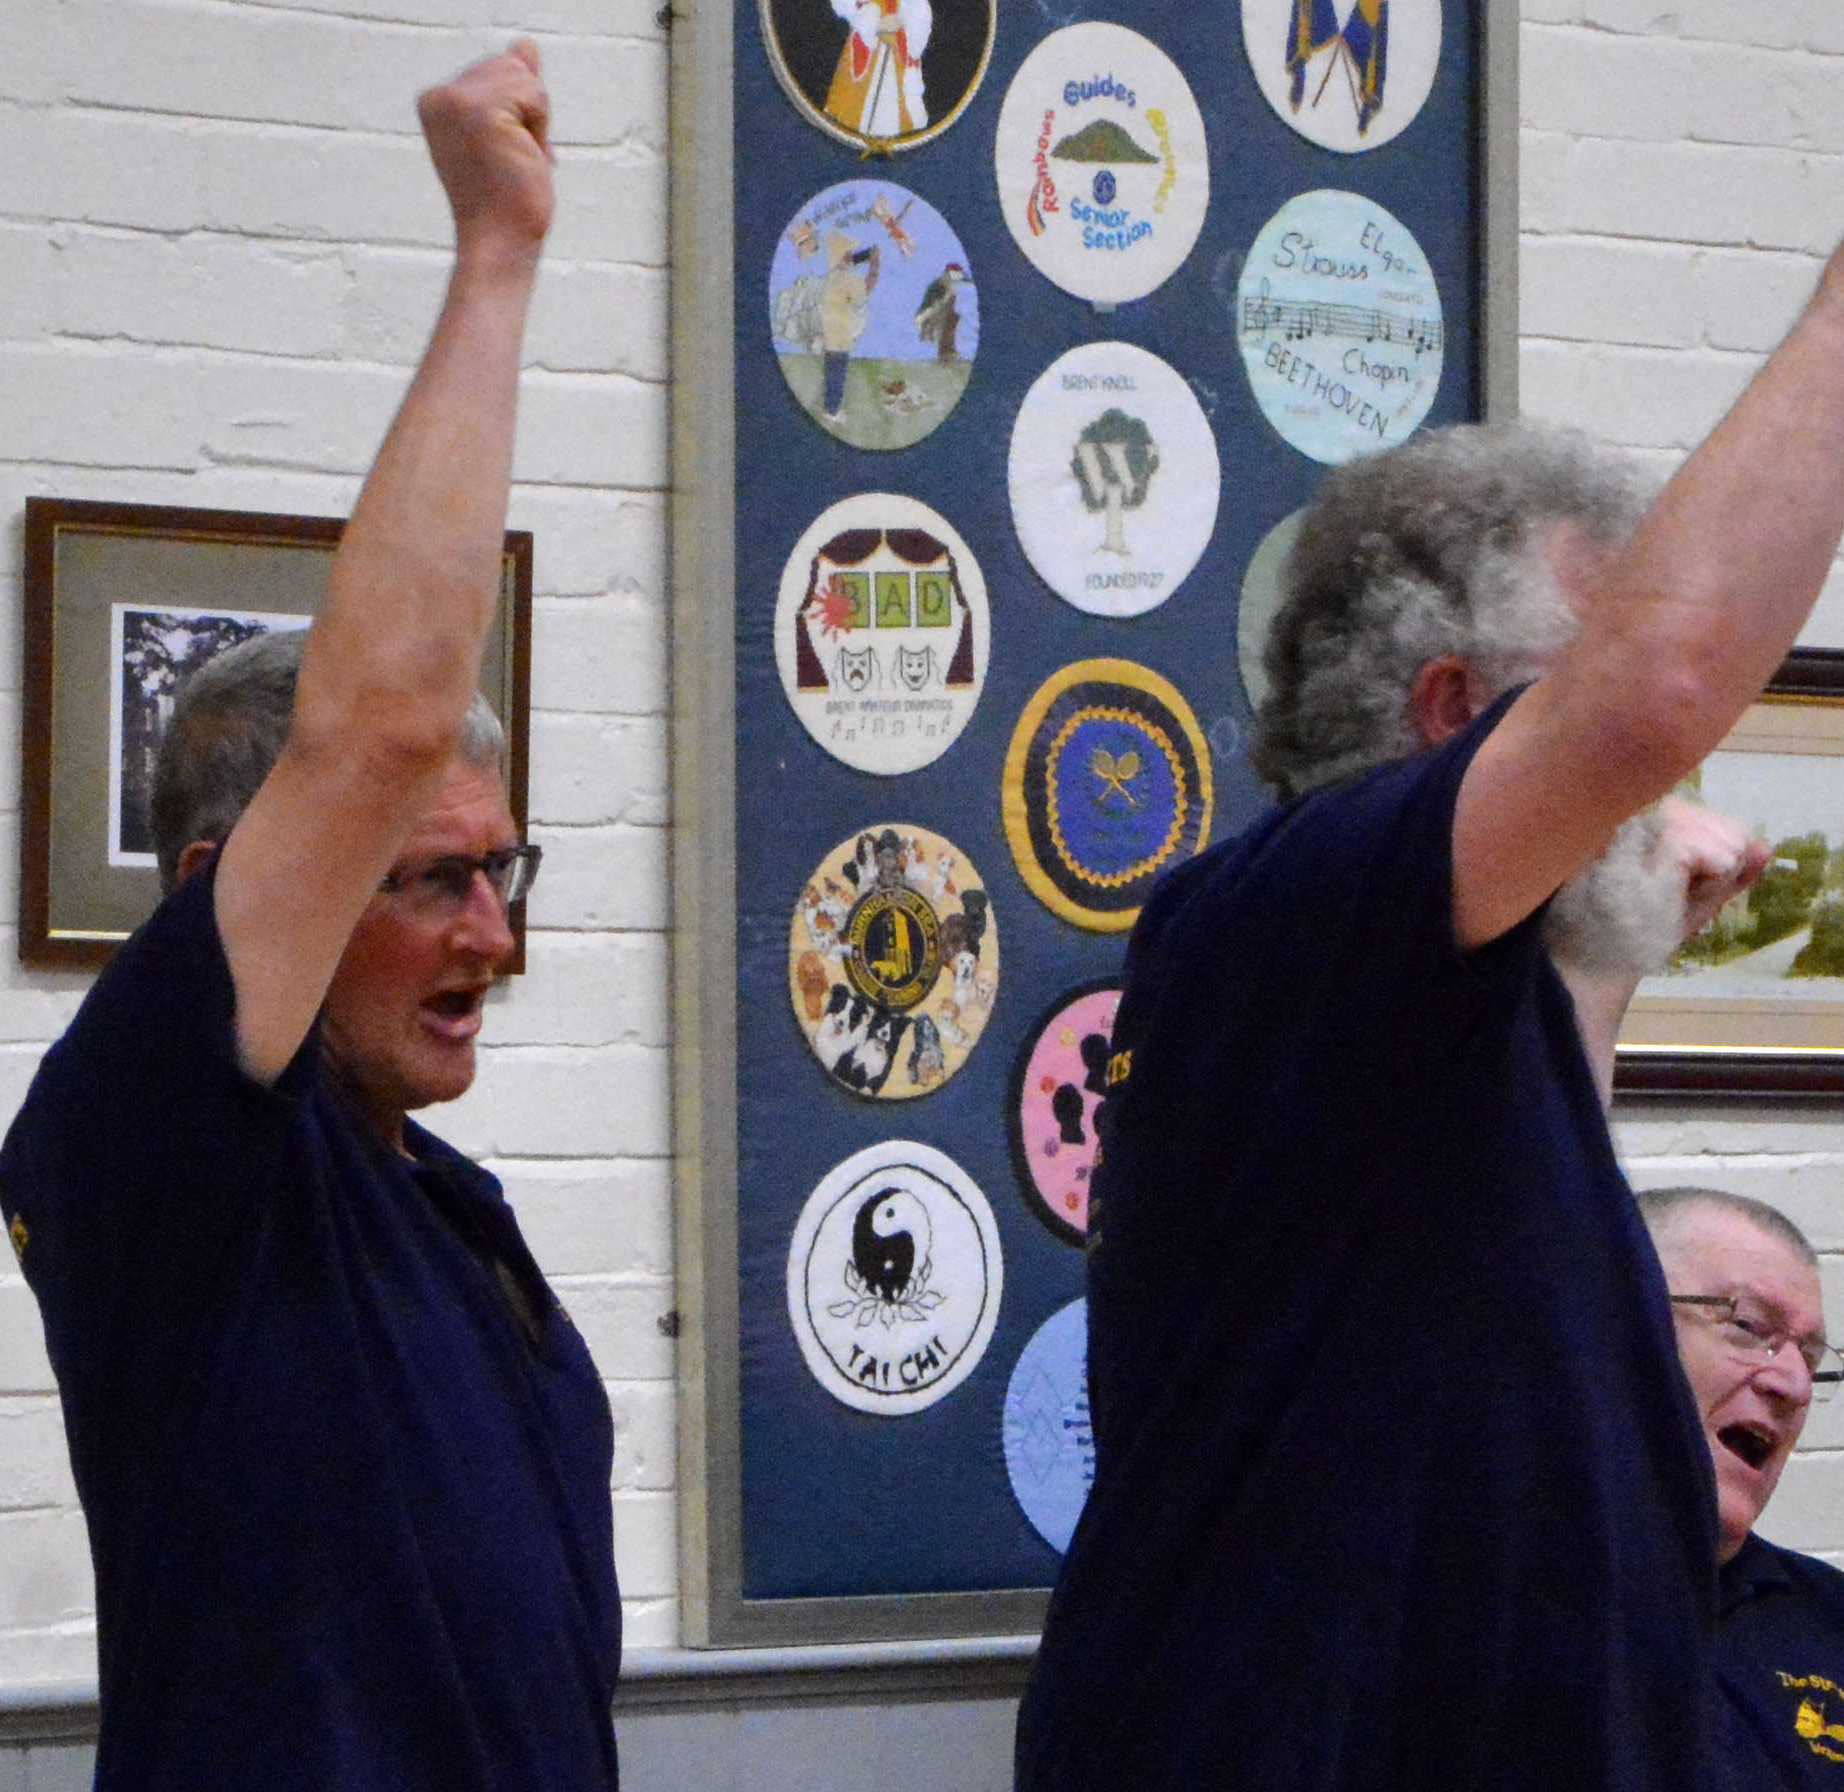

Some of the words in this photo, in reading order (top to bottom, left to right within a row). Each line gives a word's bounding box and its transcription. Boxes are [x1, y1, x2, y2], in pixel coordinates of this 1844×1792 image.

[1063, 73, 1136, 107] Guides
[1034, 109, 1059, 212] Rainbows
[1070, 197, 1130, 228] Senior
[1083, 220, 1153, 250] Section
[1273, 231, 1369, 280] Strauss
[1062, 374, 1100, 390] BRENT
[1342, 348, 1410, 390] Chopin
[1264, 342, 1389, 439] BEETHOVEN
[1086, 572, 1137, 590] FOUNDED
[848, 1343, 890, 1386] TAI
[899, 1335, 948, 1385] CHI
